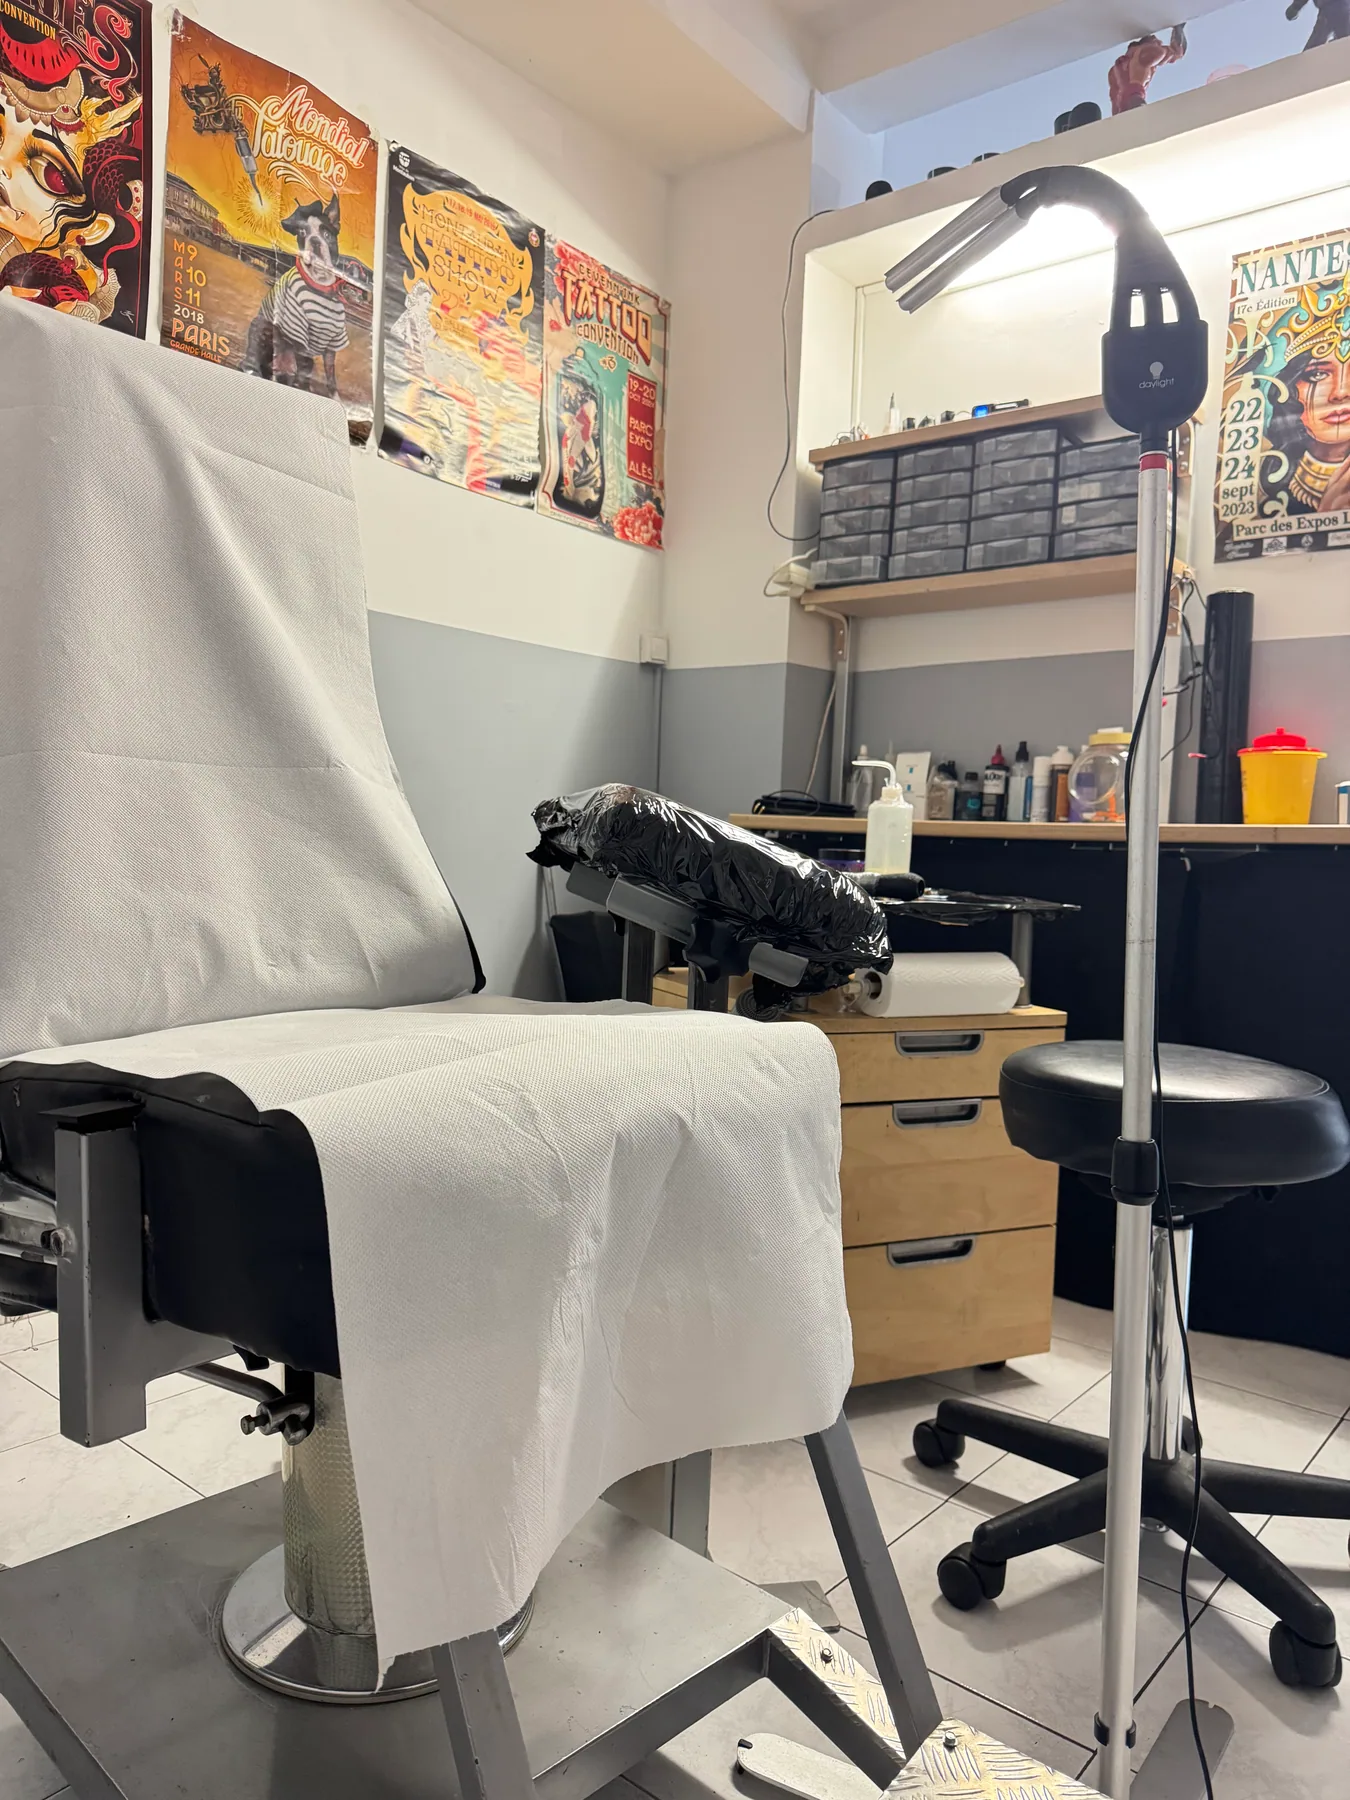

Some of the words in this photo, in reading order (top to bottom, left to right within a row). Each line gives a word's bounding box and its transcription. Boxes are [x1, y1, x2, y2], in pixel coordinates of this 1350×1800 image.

[267, 85, 369, 168] Mondial
[228, 94, 348, 187] Tatouage
[187, 244, 198, 261] 9
[186, 266, 207, 288] 10
[433, 254, 504, 304] SHOW
[1238, 240, 1350, 296] NANTE
[186, 287, 200, 307] 11
[1256, 296, 1295, 312] Édition
[174, 304, 204, 325] 2018
[561, 268, 652, 367] TATTOO
[171, 318, 231, 356] PARIS
[577, 323, 639, 364] CONVENTION
[169, 339, 200, 356] GRANDE
[200, 350, 222, 363] HALLE
[629, 378, 655, 400] 19-20
[1139, 378, 1174, 388] daylight
[1228, 396, 1262, 424] 22
[629, 416, 653, 437] PARC
[629, 432, 653, 450] EXPO
[1226, 425, 1259, 453] 23
[629, 461, 653, 480] ALÈS
[1224, 455, 1256, 481] 24
[1222, 482, 1255, 501] sept
[1221, 501, 1255, 517] 2023
[1235, 524, 1267, 537] Parc
[1270, 520, 1292, 533] des
[1296, 515, 1339, 532] Expos
